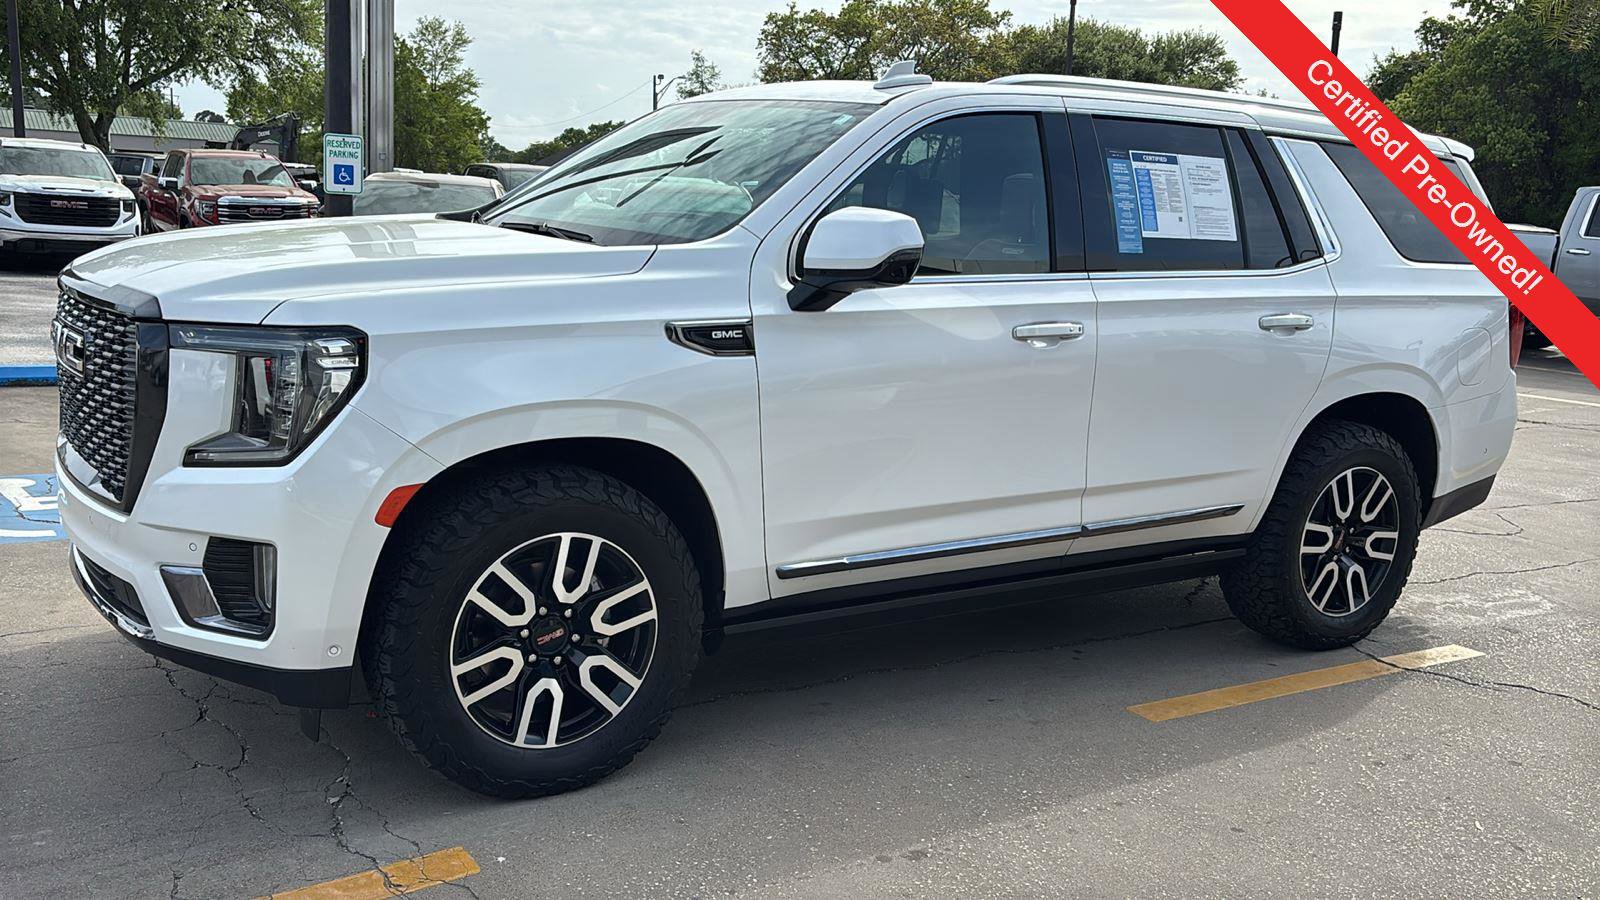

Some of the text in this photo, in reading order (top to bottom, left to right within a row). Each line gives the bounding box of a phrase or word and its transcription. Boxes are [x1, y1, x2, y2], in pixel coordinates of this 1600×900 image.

[326, 140, 361, 149] RESERVED
[329, 150, 359, 159] PARKING
[1142, 155, 1168, 163] CERTIFIED
[50, 200, 89, 209] GMC
[249, 207, 284, 215] GMC
[711, 330, 743, 339] GMC
